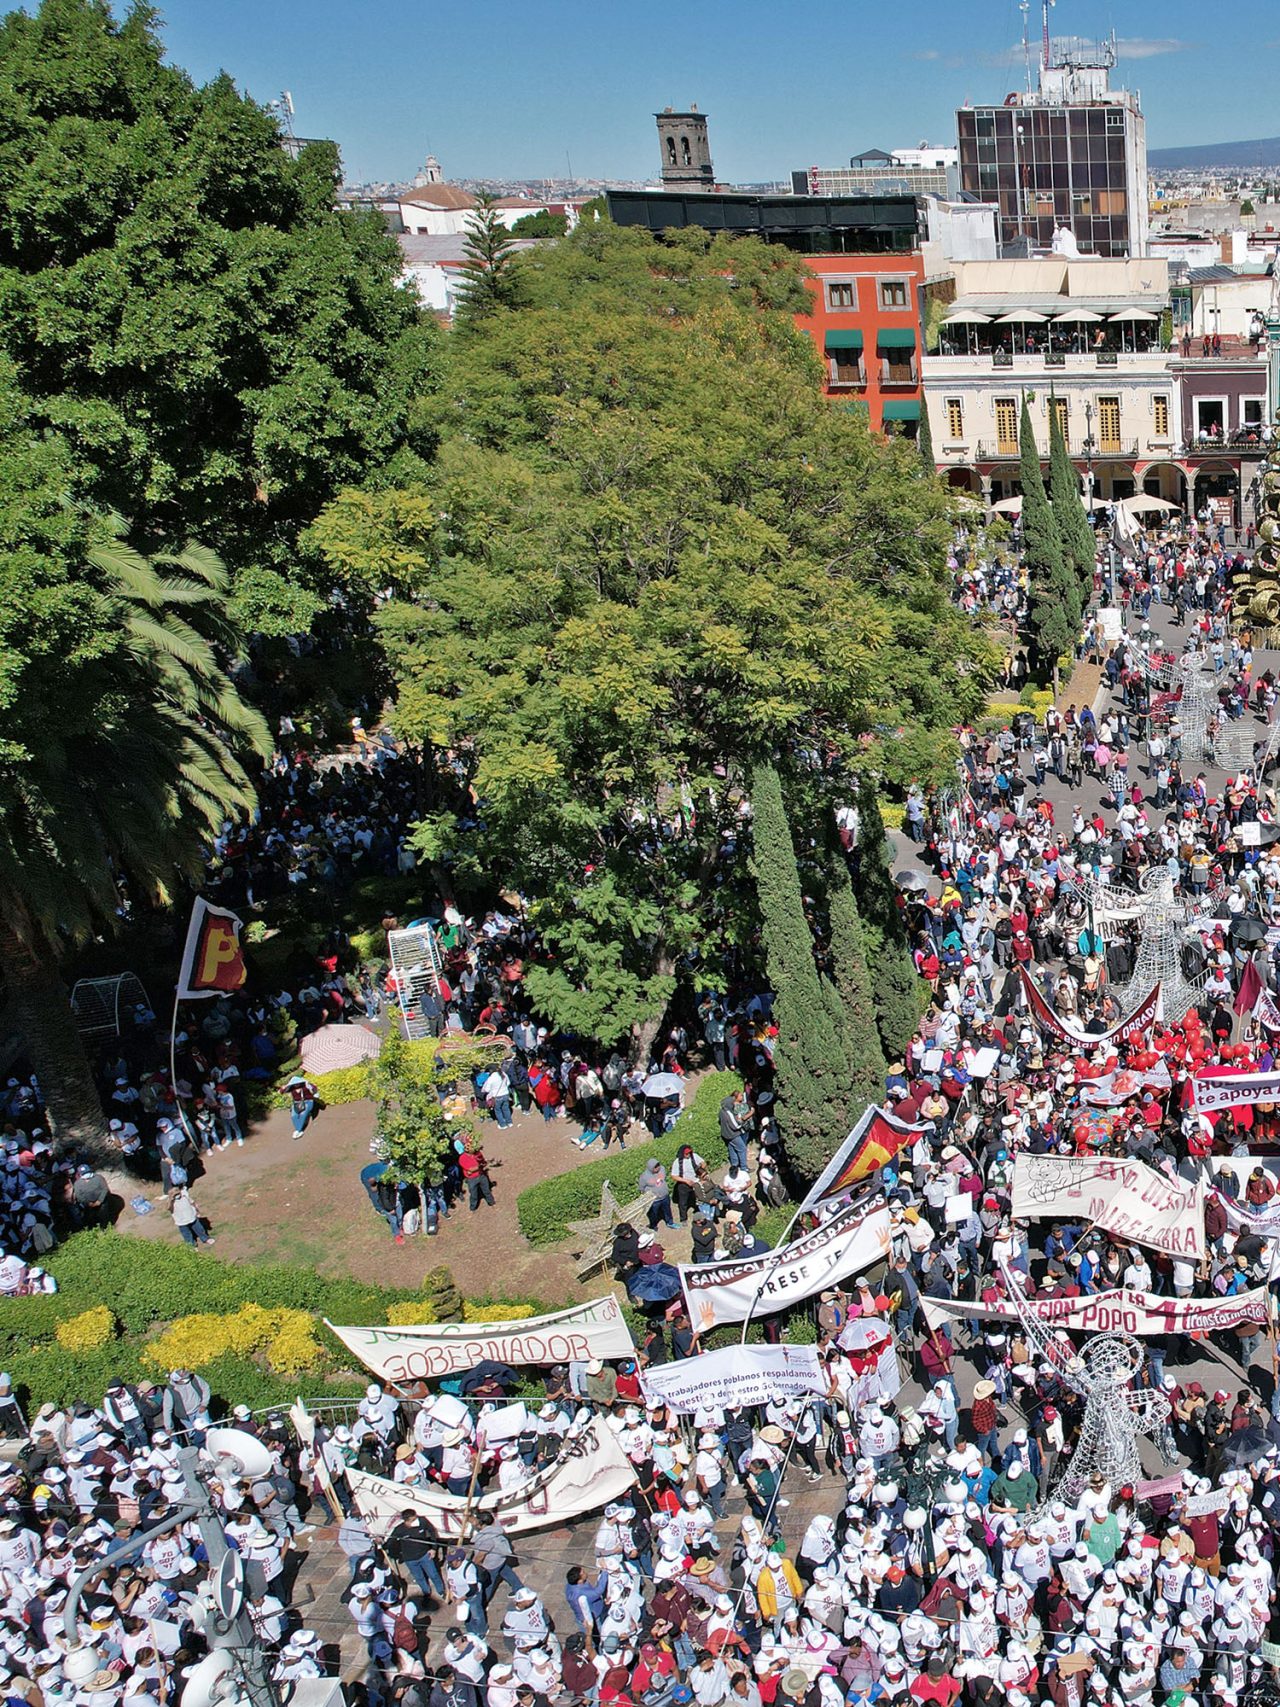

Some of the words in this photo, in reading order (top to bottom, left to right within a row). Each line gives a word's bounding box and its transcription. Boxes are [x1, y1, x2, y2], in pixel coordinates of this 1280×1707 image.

[1197, 1094, 1215, 1106] te
[1219, 1085, 1272, 1102] apoya
[691, 1268, 722, 1286] SAN
[800, 1233, 826, 1255] LOS
[757, 1249, 842, 1299] PRESETE
[1082, 1302, 1137, 1333] POPO
[383, 1333, 595, 1381] GOBERNADOR
[668, 1379, 722, 1398] trabajadores
[724, 1372, 760, 1387] poblanos
[762, 1369, 818, 1382] respaldamos
[1201, 1594, 1211, 1602] YO
